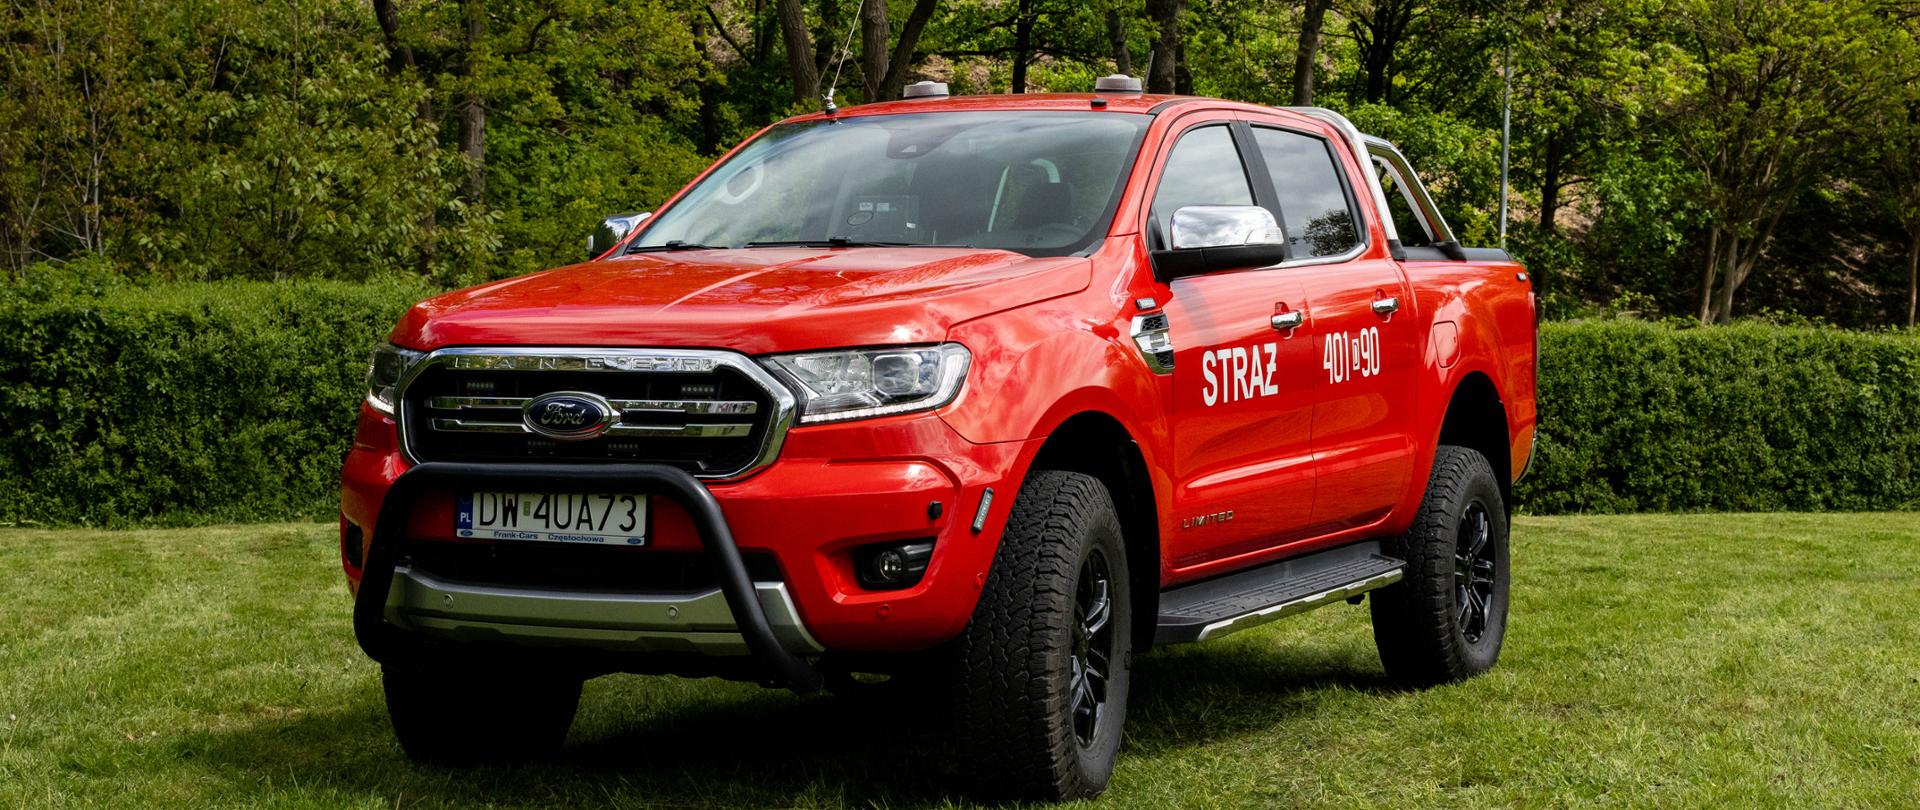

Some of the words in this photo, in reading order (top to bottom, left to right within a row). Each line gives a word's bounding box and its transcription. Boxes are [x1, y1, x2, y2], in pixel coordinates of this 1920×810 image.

[541, 402, 586, 425] Ford
[460, 511, 472, 523] PL
[479, 492, 518, 528] DW
[533, 493, 637, 533] 4UA73
[1182, 510, 1234, 529] LIMITED
[493, 530, 539, 540] Frank-Cars
[547, 533, 605, 543] Częstochowa
